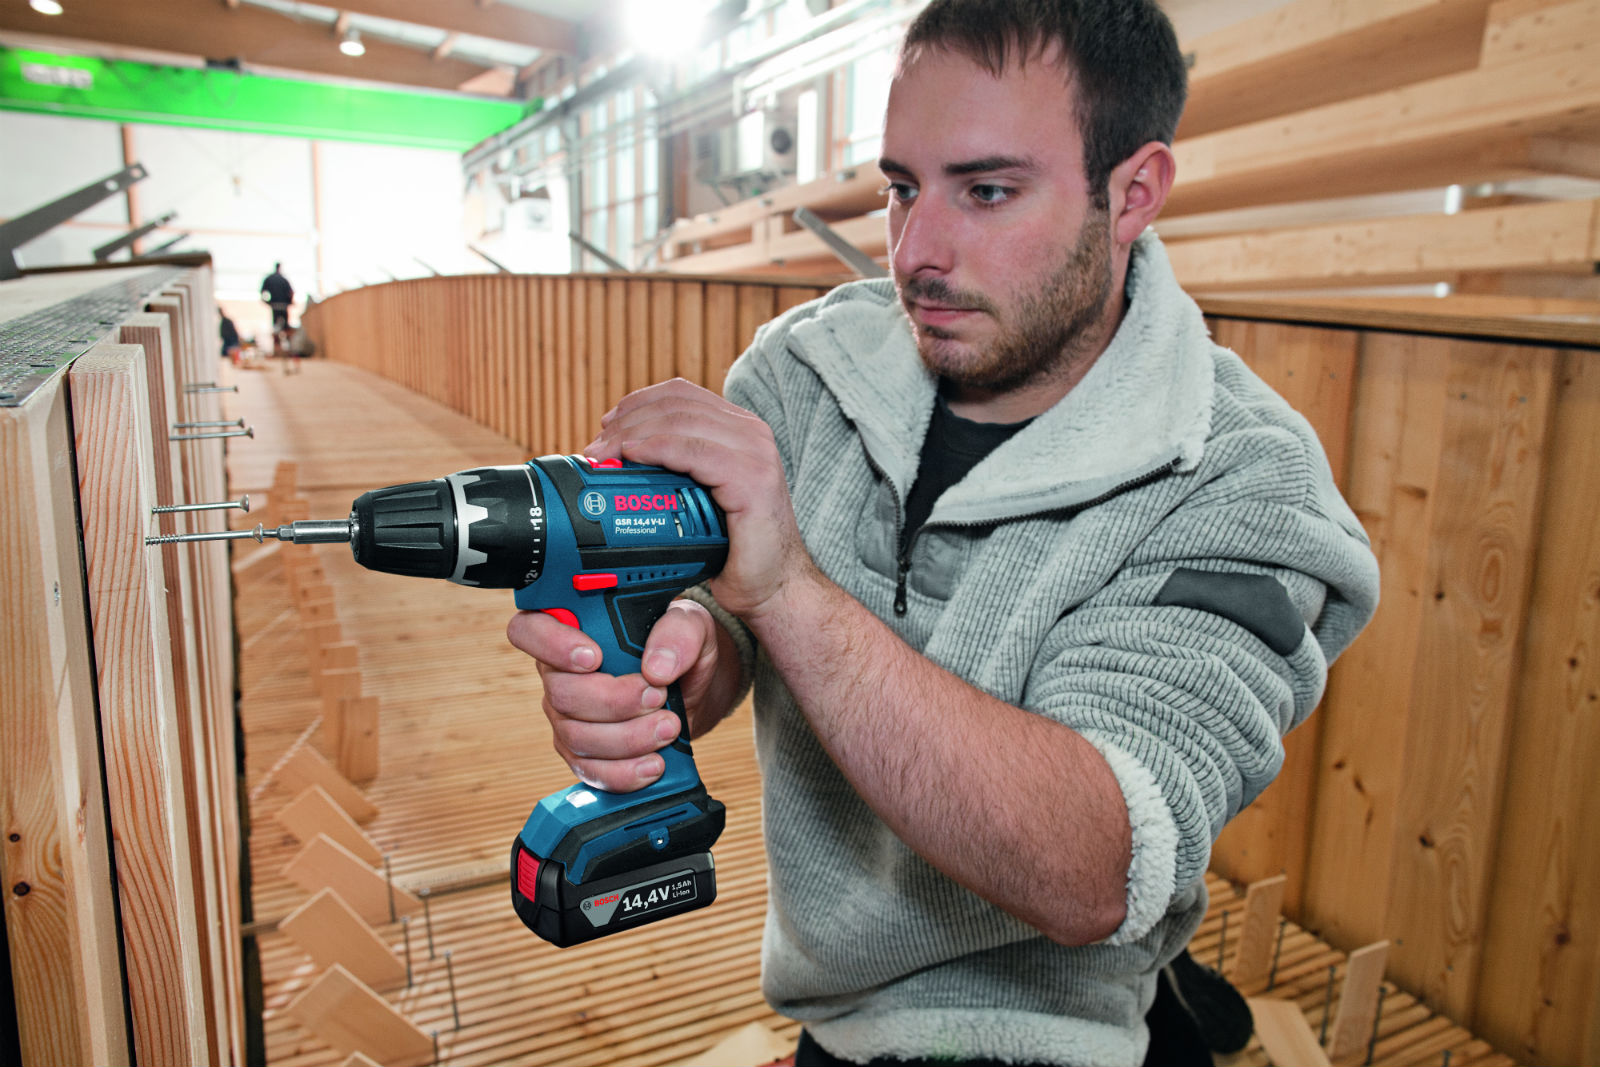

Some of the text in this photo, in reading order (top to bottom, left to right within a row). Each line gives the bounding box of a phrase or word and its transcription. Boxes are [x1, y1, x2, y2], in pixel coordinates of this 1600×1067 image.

[614, 495, 678, 511] BOSCH
[529, 506, 543, 526] 18
[615, 518, 632, 526] GSR
[615, 526, 657, 534] Professional
[594, 885, 670, 912] BOSCH 14,4V
